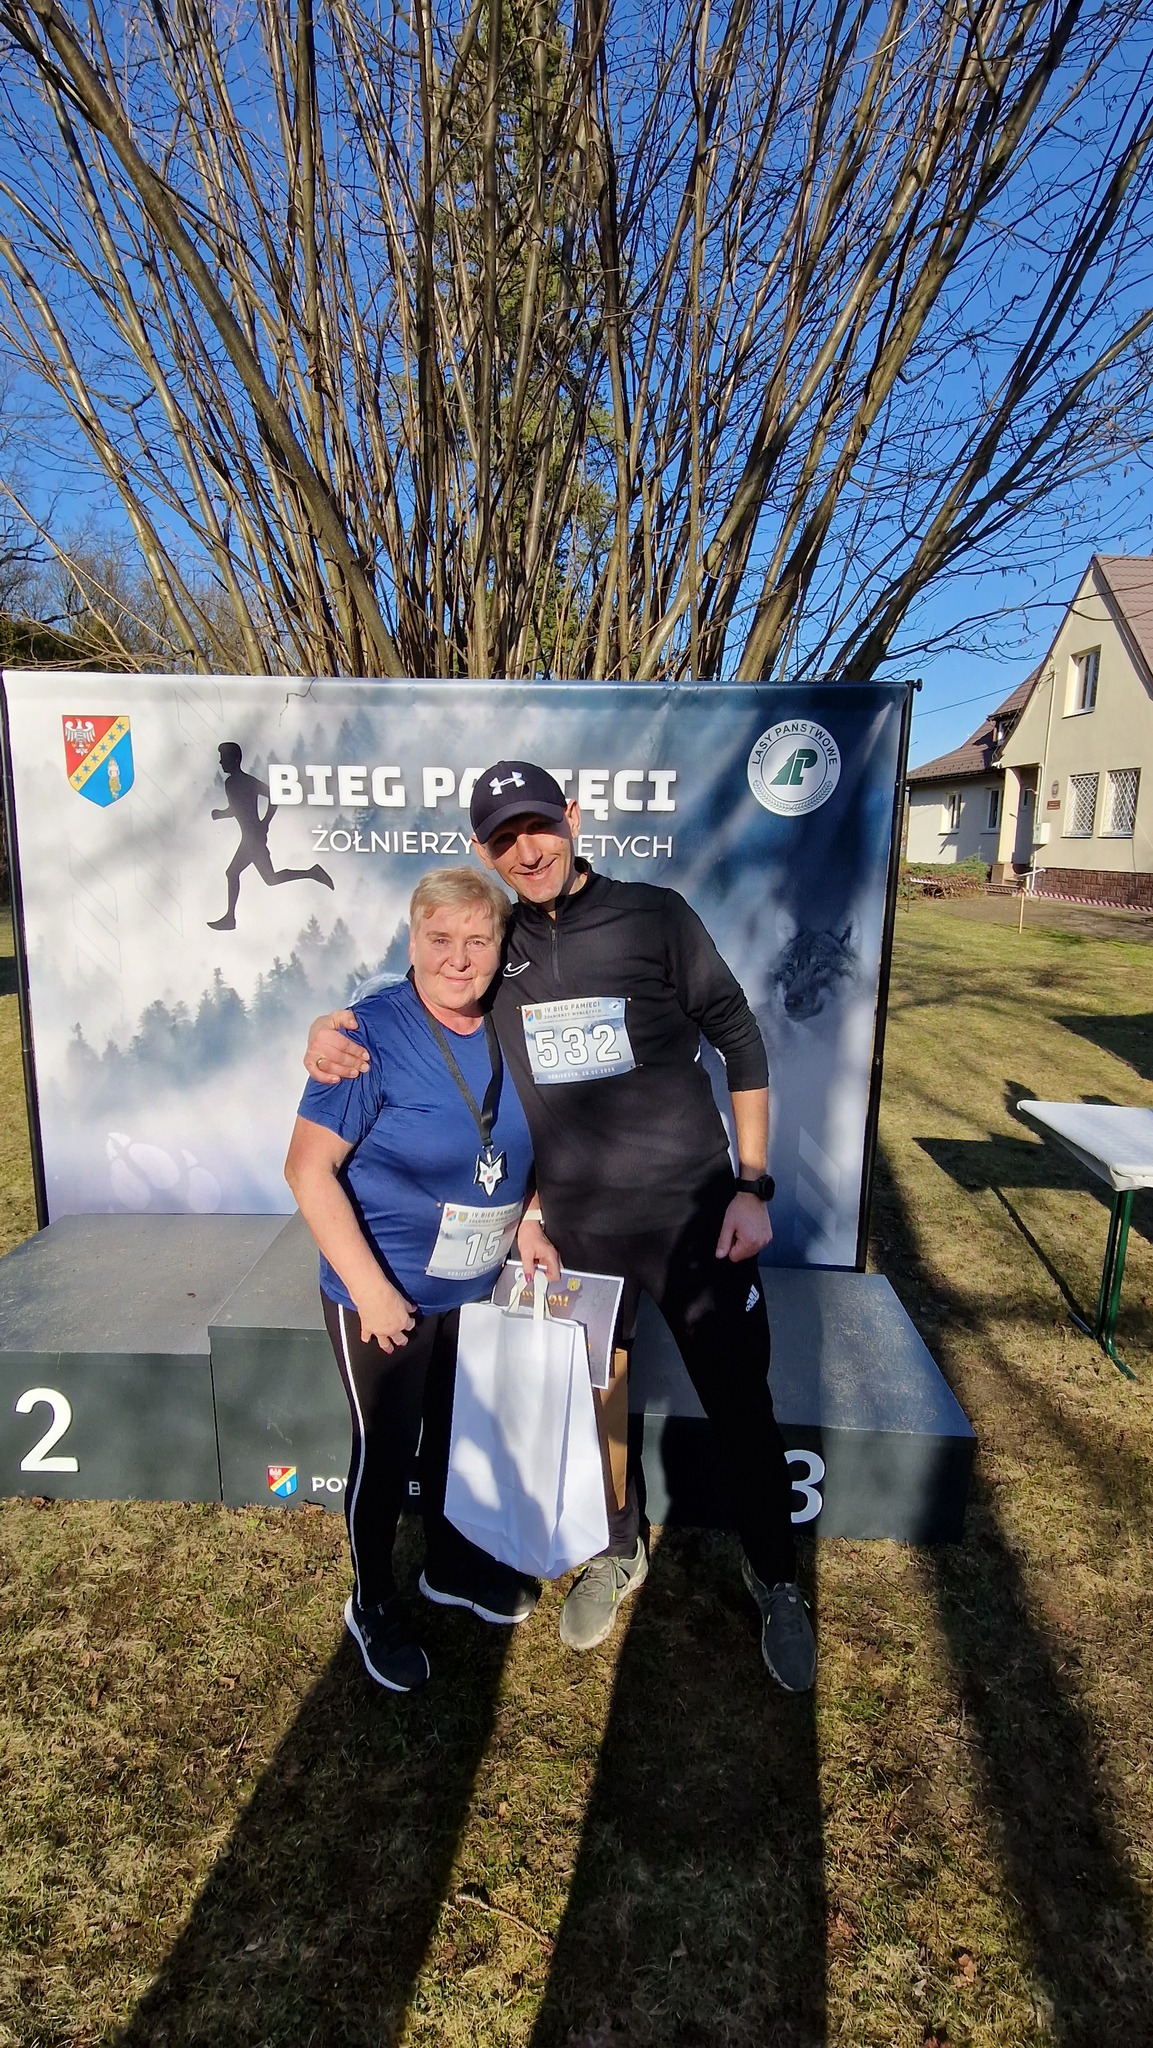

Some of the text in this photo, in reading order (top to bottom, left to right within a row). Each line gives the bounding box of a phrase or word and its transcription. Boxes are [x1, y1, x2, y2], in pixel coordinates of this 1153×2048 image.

[751, 721, 838, 766] LASY PAŃSTWOWE
[268, 764, 406, 807] BIEG
[311, 824, 473, 855] ŻOŁNIERZY
[553, 1004, 569, 1012] BIEG
[535, 1024, 622, 1068] 532
[465, 1228, 504, 1266] 15
[15, 1387, 80, 1473] 2
[784, 1449, 826, 1524] 3
